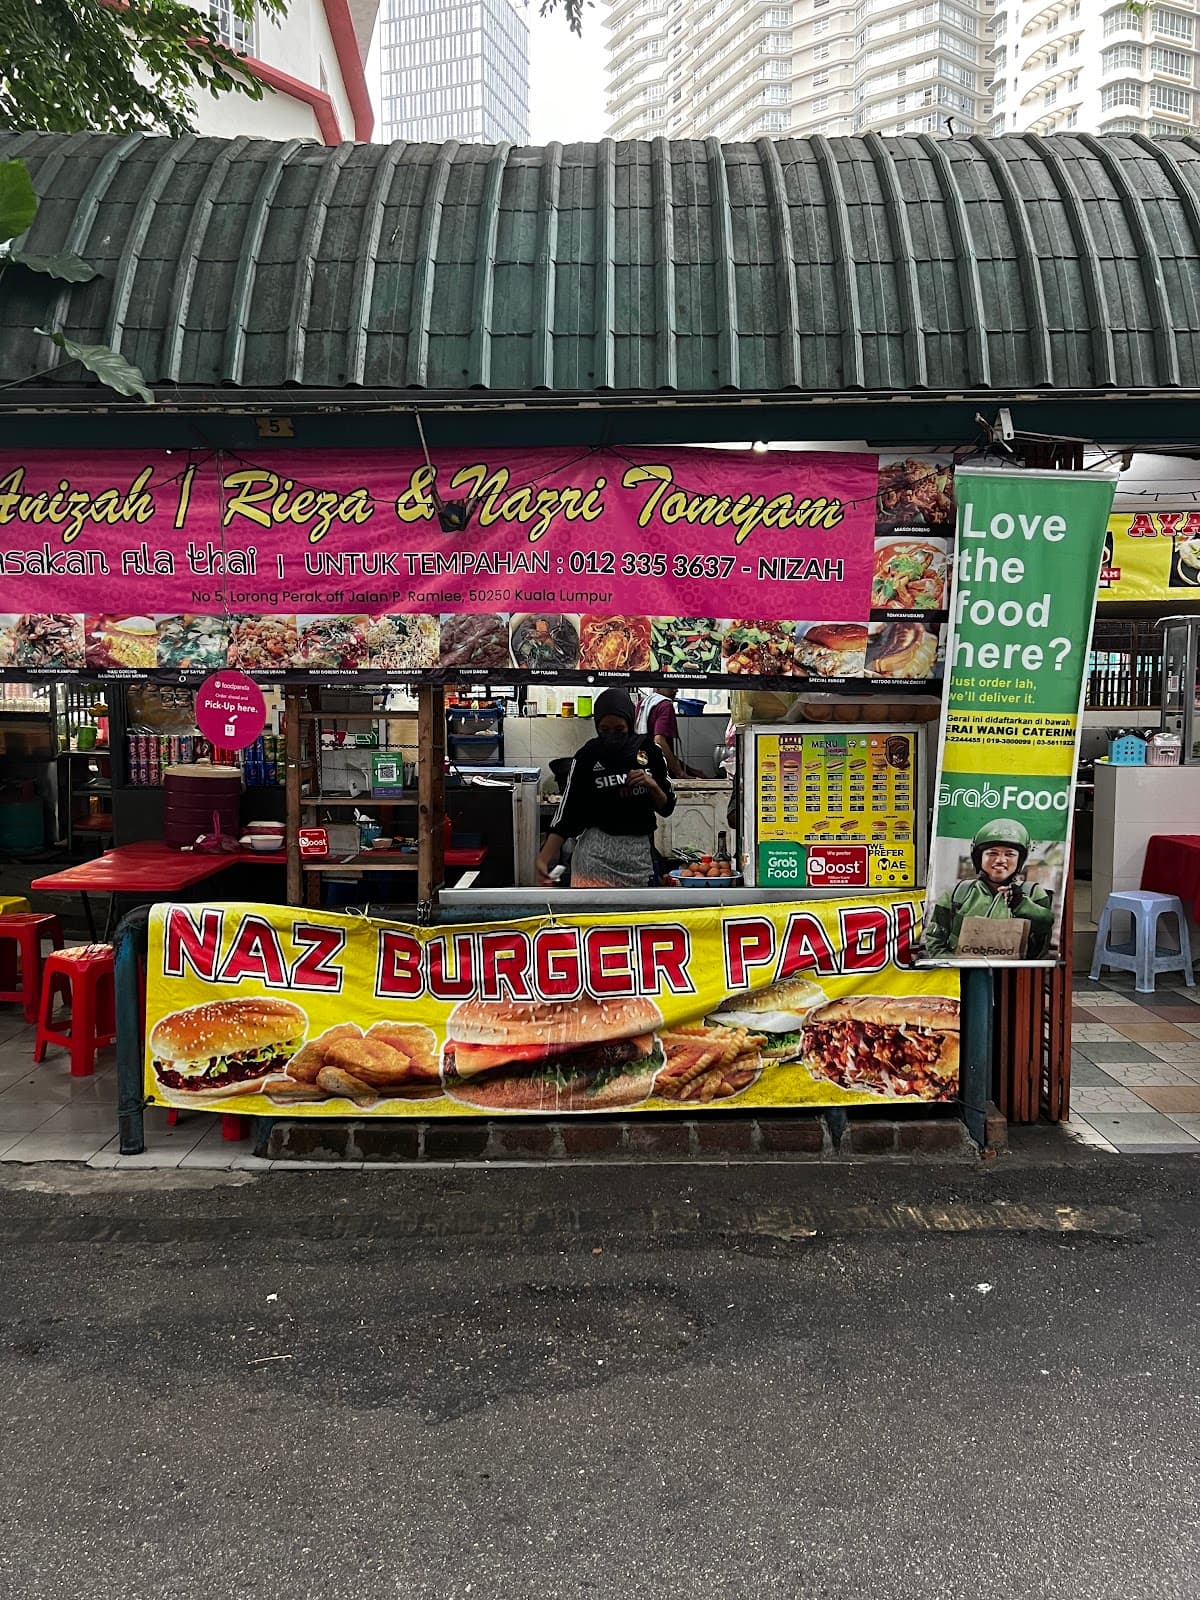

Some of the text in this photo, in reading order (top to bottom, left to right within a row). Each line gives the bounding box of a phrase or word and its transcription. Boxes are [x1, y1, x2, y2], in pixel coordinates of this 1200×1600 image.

[270, 420, 281, 433] 5
[223, 469, 375, 544] Rieza
[397, 463, 437, 522] &
[450, 462, 607, 542] Nazri
[621, 464, 845, 545] Tomyam
[963, 503, 1067, 542] Love
[304, 551, 400, 576] UNTUK
[402, 550, 550, 576] TEMPAHAN
[568, 551, 615, 575] 012
[621, 551, 667, 577] 335
[672, 554, 736, 579] 3637
[758, 557, 844, 581] NIZAH
[958, 548, 1025, 584] the
[192, 591, 211, 603] No
[231, 591, 278, 606] Lorong
[283, 591, 322, 603] Perak
[326, 590, 345, 603] off
[348, 591, 388, 603] Jalan
[392, 591, 404, 603] P.
[409, 590, 465, 605] Ramlee,
[469, 589, 511, 602] 50250
[515, 590, 556, 602] Kuala
[560, 589, 613, 605] Lumpur
[955, 590, 1051, 628] food
[951, 633, 1072, 671] here?
[222, 682, 250, 690] foodpanda
[950, 676, 1036, 690] Just order lah,
[949, 691, 1035, 704] we'll deliver it.
[205, 700, 258, 713] Pick-Up here.
[1045, 718, 1071, 726] bawah
[977, 725, 1018, 735] WANGI
[768, 857, 798, 868] Grab
[767, 868, 798, 878] Food
[163, 905, 347, 993] NAZ
[375, 922, 697, 1003] BURGER
[960, 944, 1016, 957] GrabFood
